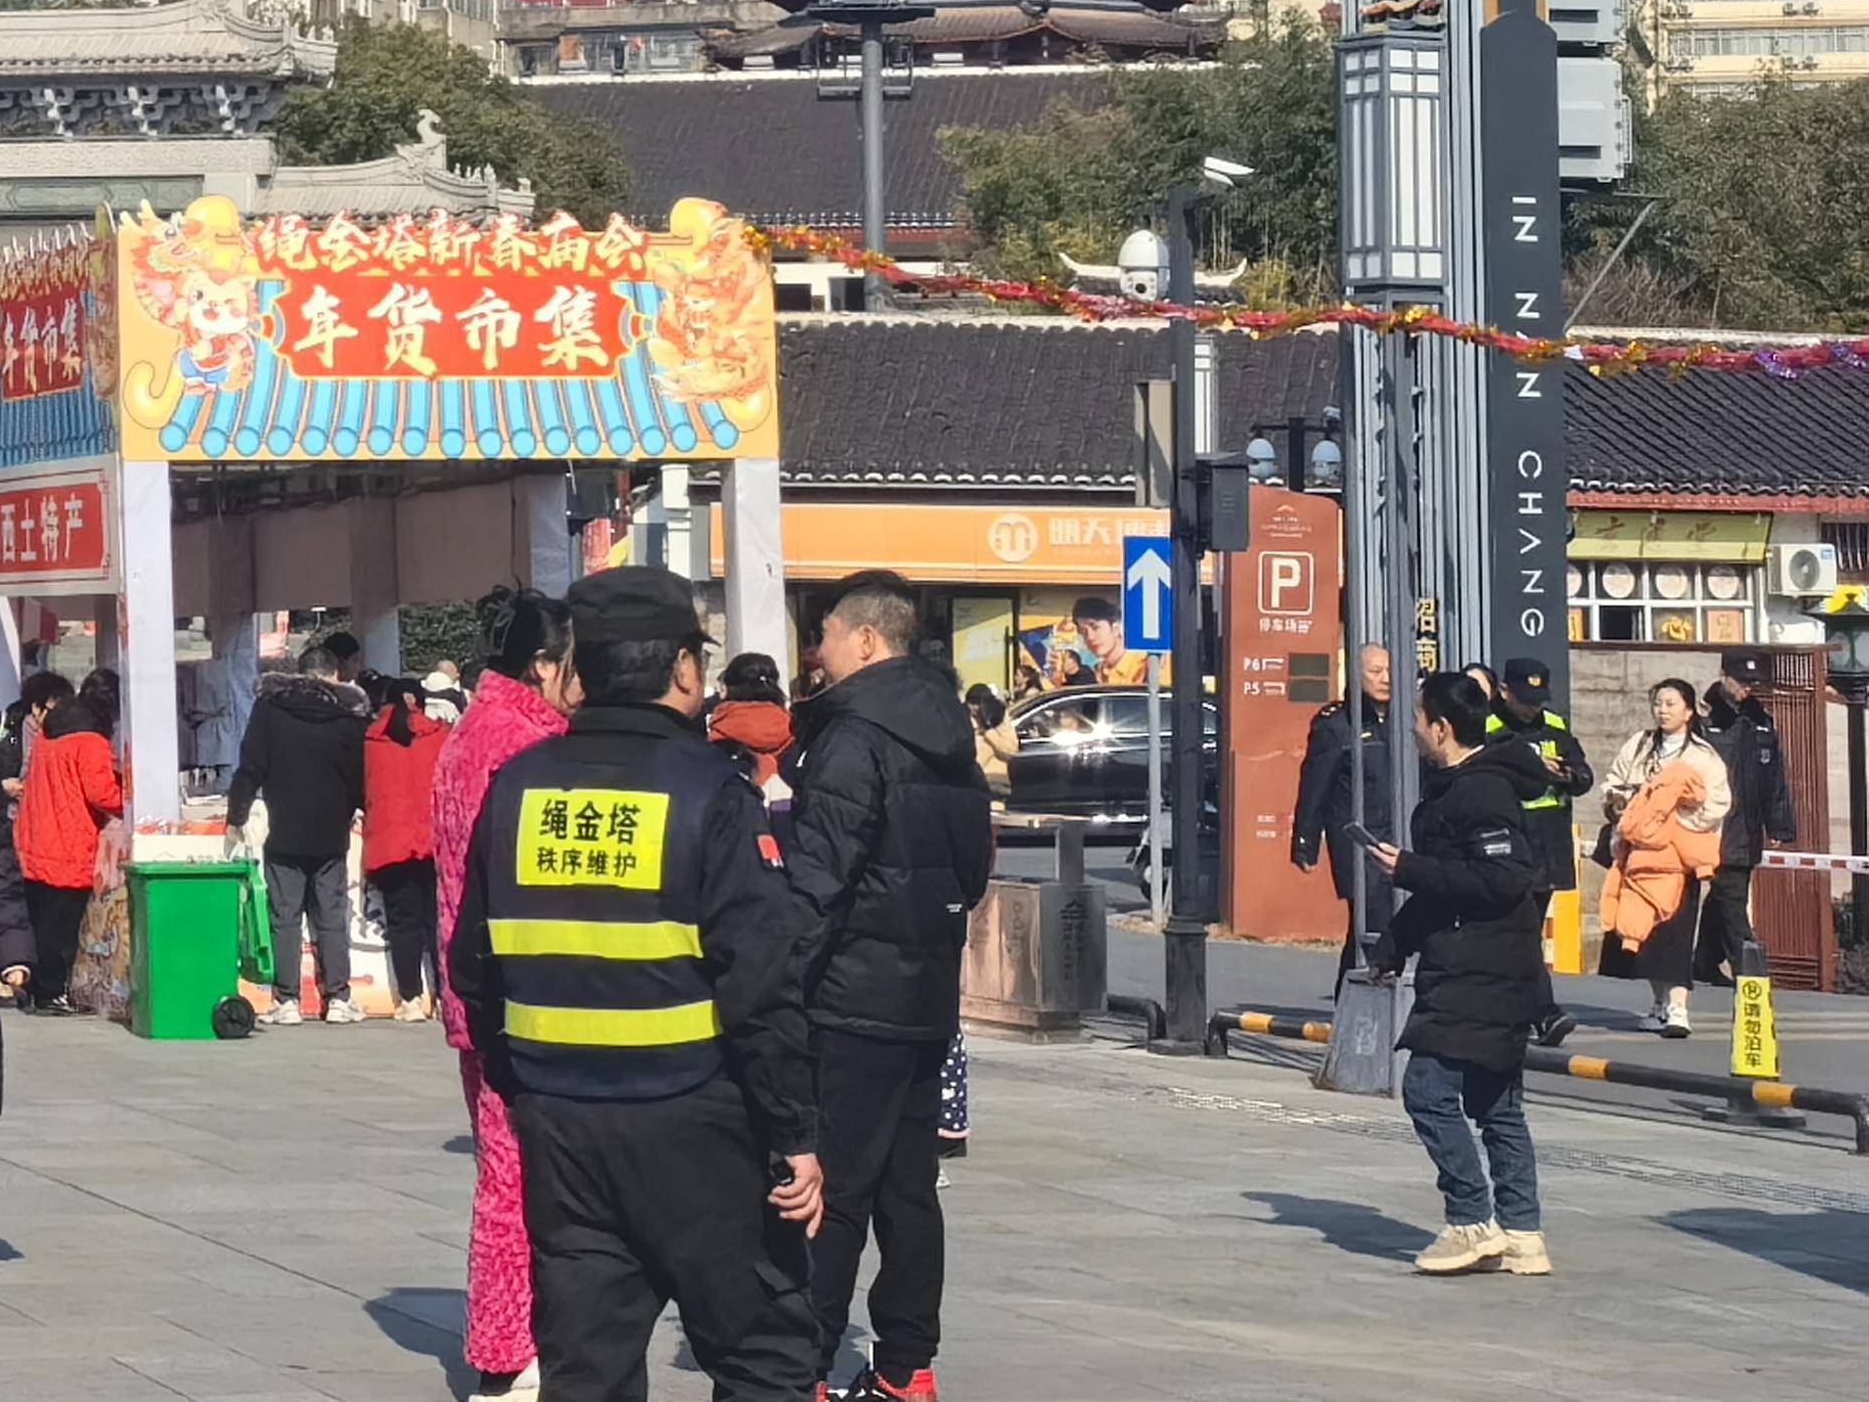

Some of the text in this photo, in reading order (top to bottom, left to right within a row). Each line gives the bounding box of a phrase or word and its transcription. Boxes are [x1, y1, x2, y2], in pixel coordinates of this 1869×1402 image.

[259, 211, 647, 273] 绳金塔新春庙会
[293, 284, 611, 376] 年货市集
[1514, 292, 1542, 398] NN
[1271, 557, 1301, 608] P
[539, 800, 642, 845] 绳金塔
[536, 846, 637, 878] 秩序维护
